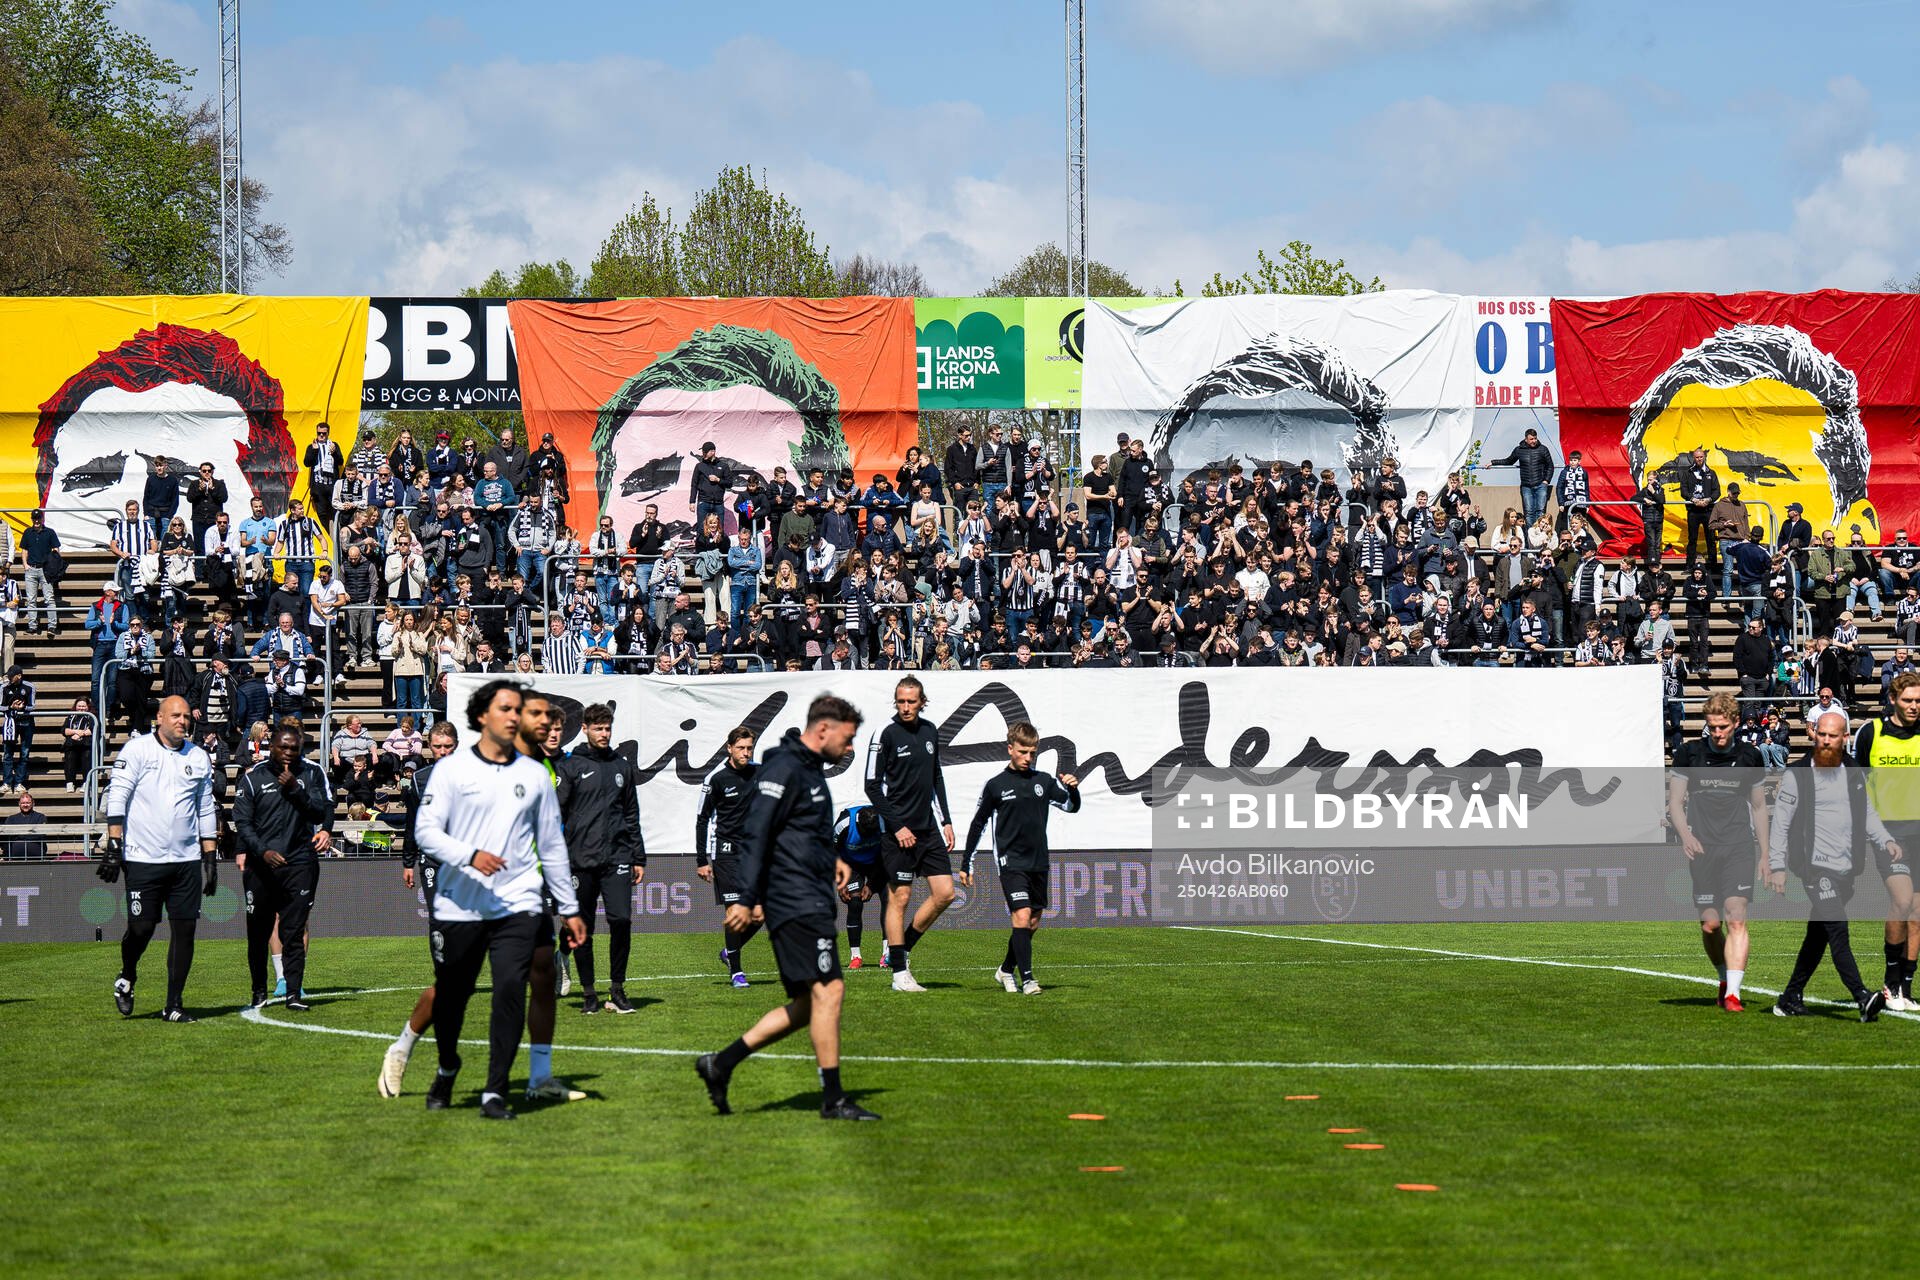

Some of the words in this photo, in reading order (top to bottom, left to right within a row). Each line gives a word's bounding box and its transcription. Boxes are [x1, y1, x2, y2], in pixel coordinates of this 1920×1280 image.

[1478, 301, 1505, 315] HOS
[1509, 301, 1536, 315] OSS
[936, 346, 995, 360] LANDS
[936, 361, 1001, 375] KRONA
[936, 375, 975, 390] HEM
[381, 387, 432, 402] BYGG
[437, 388, 451, 402] &
[1475, 381, 1523, 406] BÅDE
[1529, 381, 1554, 406] PÅ
[722, 842, 732, 852] 21
[427, 879, 435, 888] 5
[1435, 867, 1628, 911] UNIBET
[130, 891, 142, 900] TK
